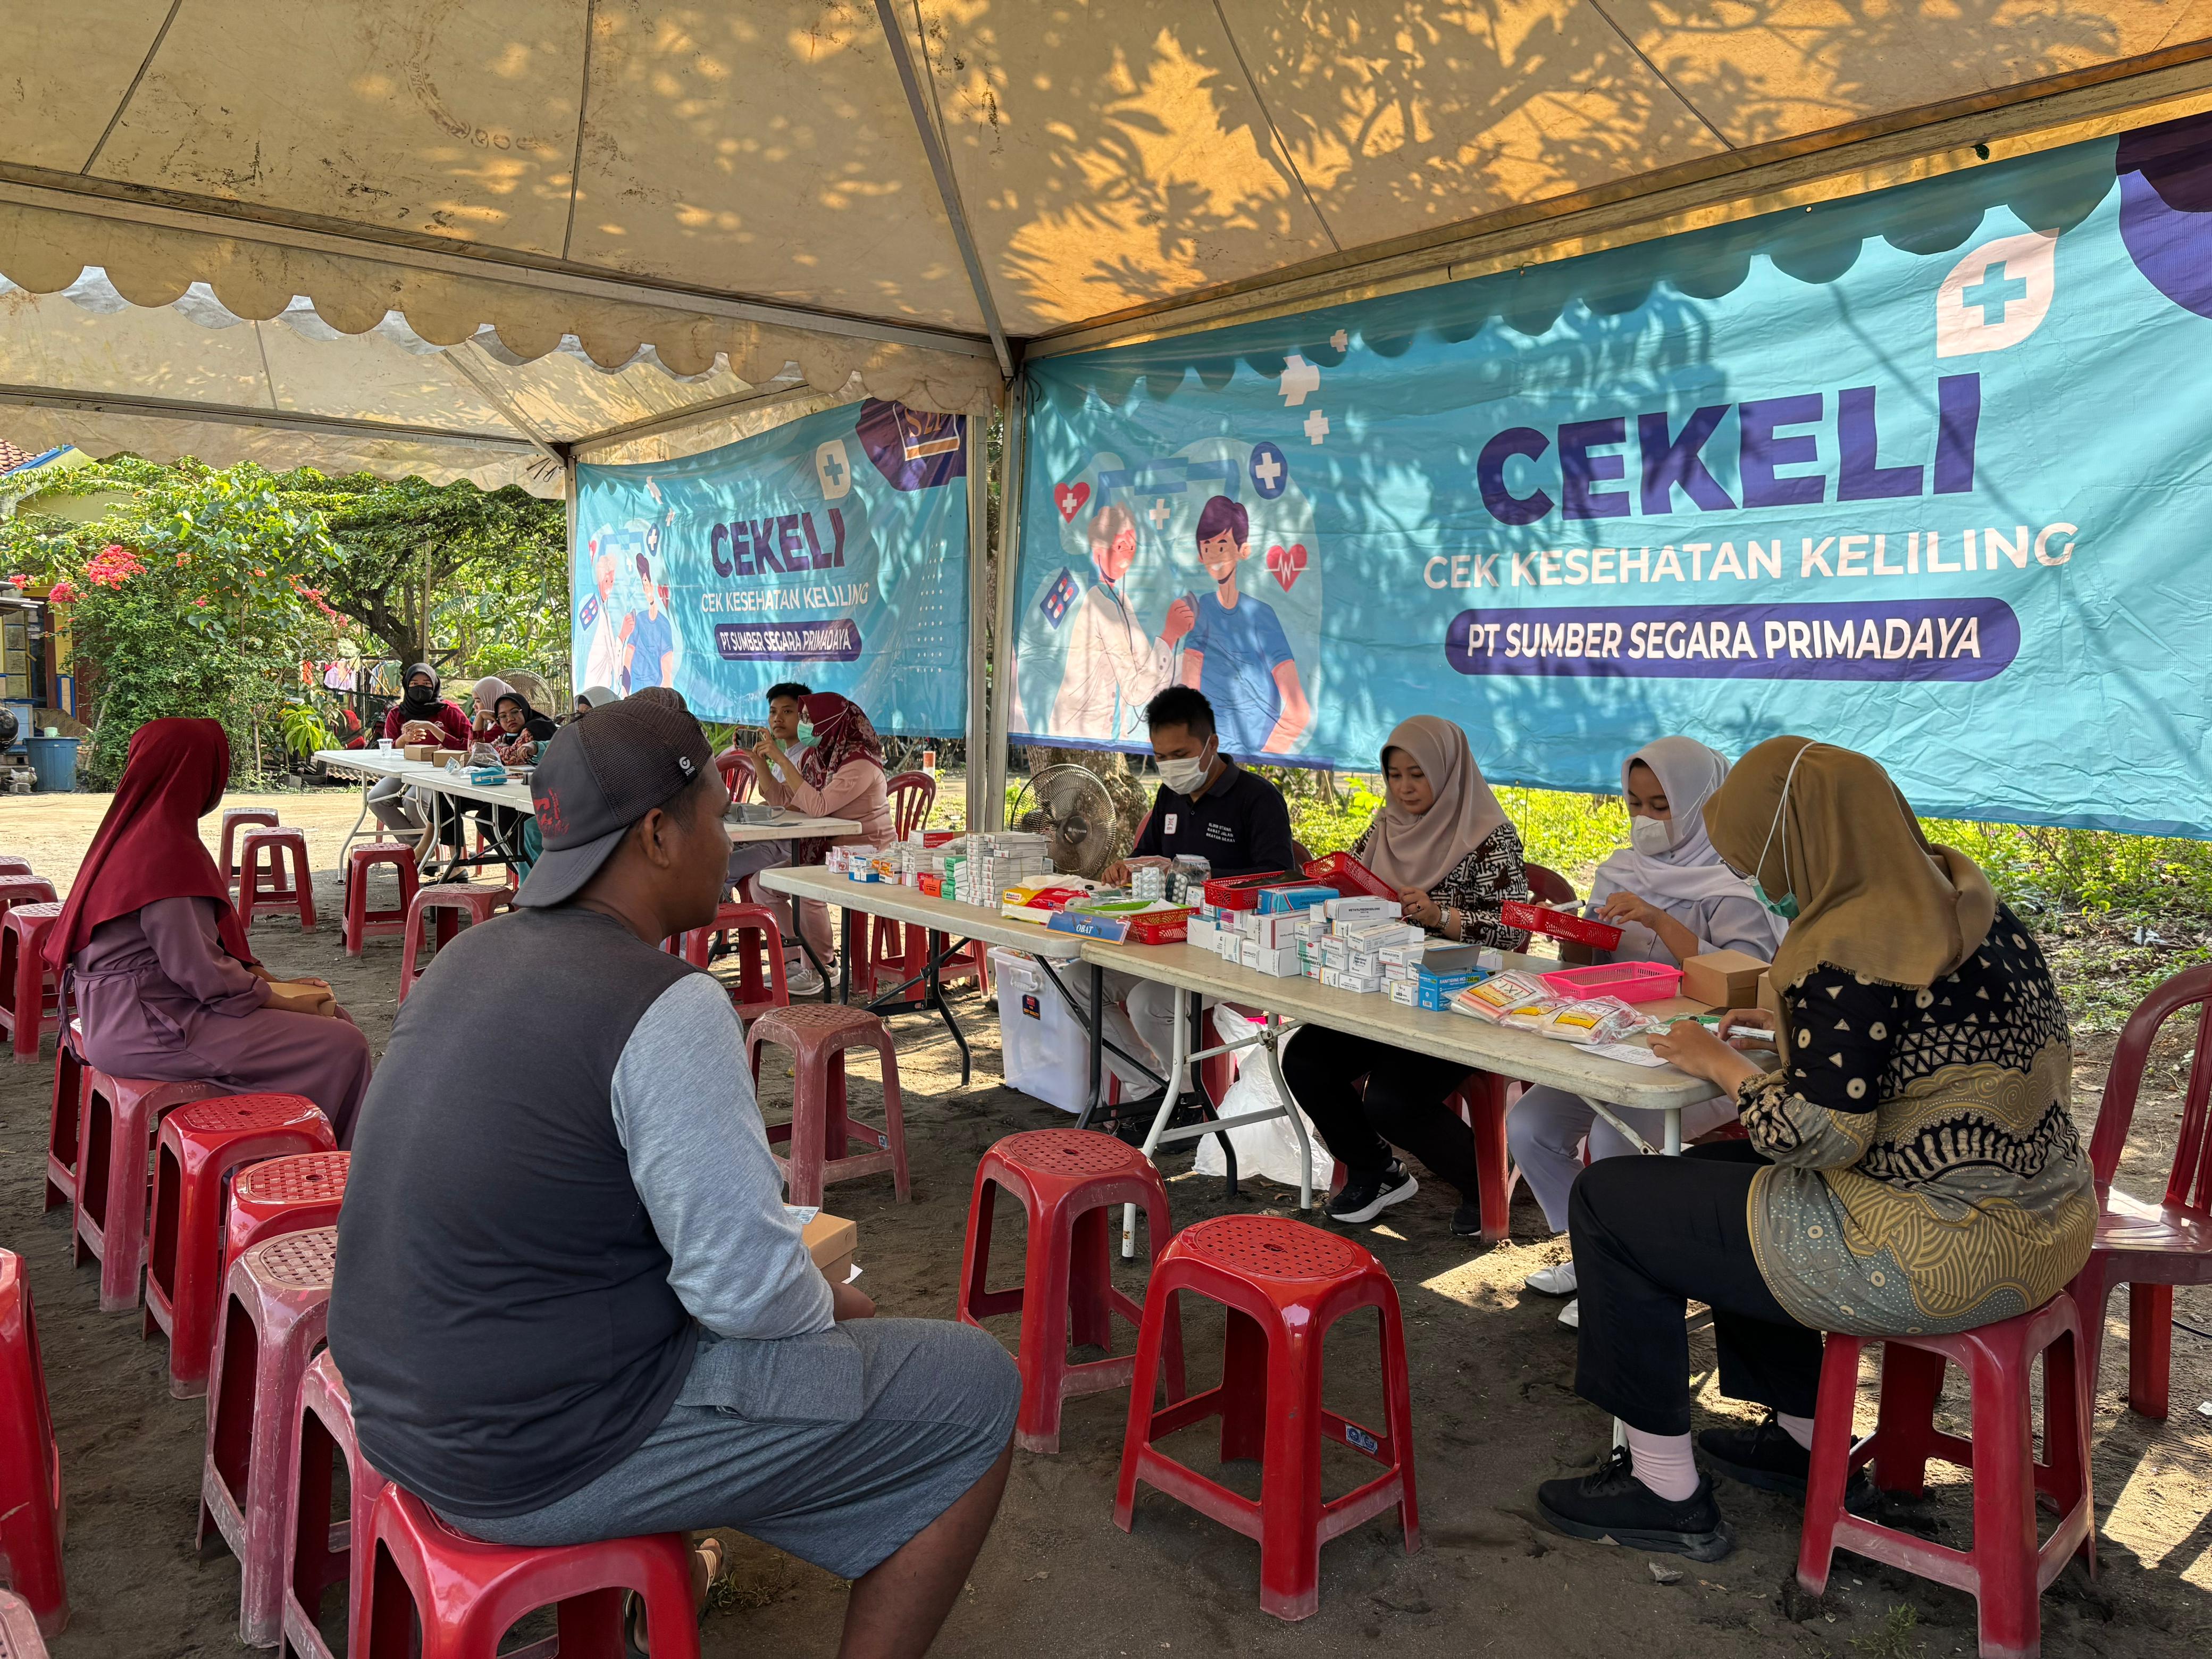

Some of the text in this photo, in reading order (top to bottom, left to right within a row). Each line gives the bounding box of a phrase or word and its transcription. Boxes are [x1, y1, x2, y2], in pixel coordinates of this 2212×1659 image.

[1477, 372, 1981, 526] CEKELI
[711, 508, 845, 578] CEKELI
[1423, 522, 2079, 589] CEK KESEHATAN KELILING
[701, 582, 869, 613] CEK KESEHATAN KELILING
[719, 629, 852, 651] PT SUMBER SEGARA PRIMADAYA
[1467, 616, 1981, 660] PT SUMBER SEGARA PRIMADAYA
[1076, 924, 1094, 934] OBAT
